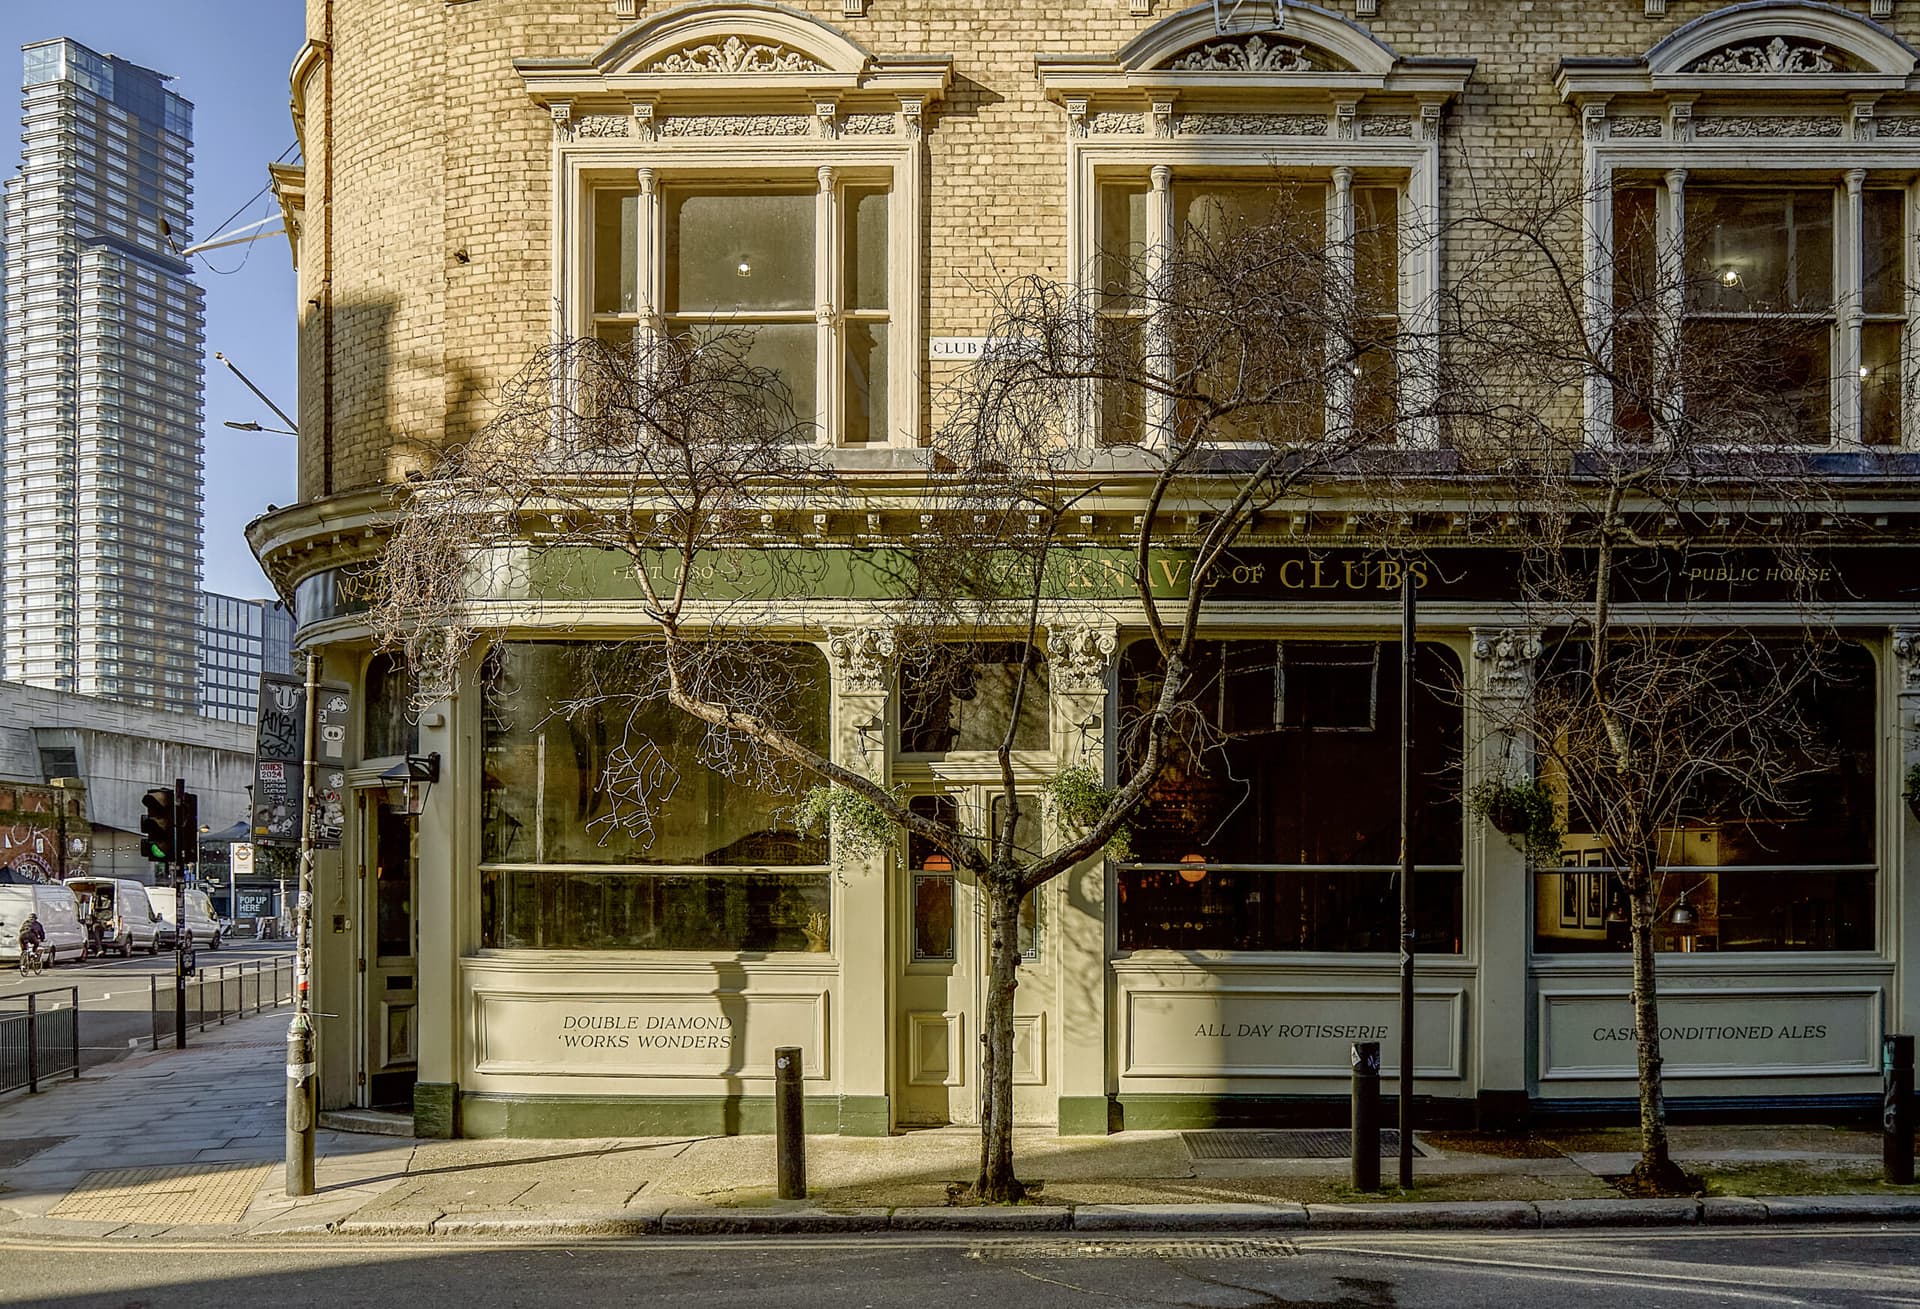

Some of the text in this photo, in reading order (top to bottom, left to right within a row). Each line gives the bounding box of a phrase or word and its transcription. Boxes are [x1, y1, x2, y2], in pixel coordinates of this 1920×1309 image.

[933, 342, 977, 354] CLUB
[624, 566, 663, 579] ET.
[1232, 565, 1264, 584] OF
[1279, 559, 1429, 589] CLUBS
[1690, 568, 1832, 581] PUBLIC HOUSE
[239, 896, 267, 904] POP UP
[239, 904, 261, 912] HERE
[563, 1016, 733, 1030] DOUBLE DIAMOND
[1195, 1024, 1389, 1039] ALL DAY ROTISSERIE
[1660, 1026, 1773, 1040] ONDITIONED
[1778, 1025, 1827, 1039] ALES
